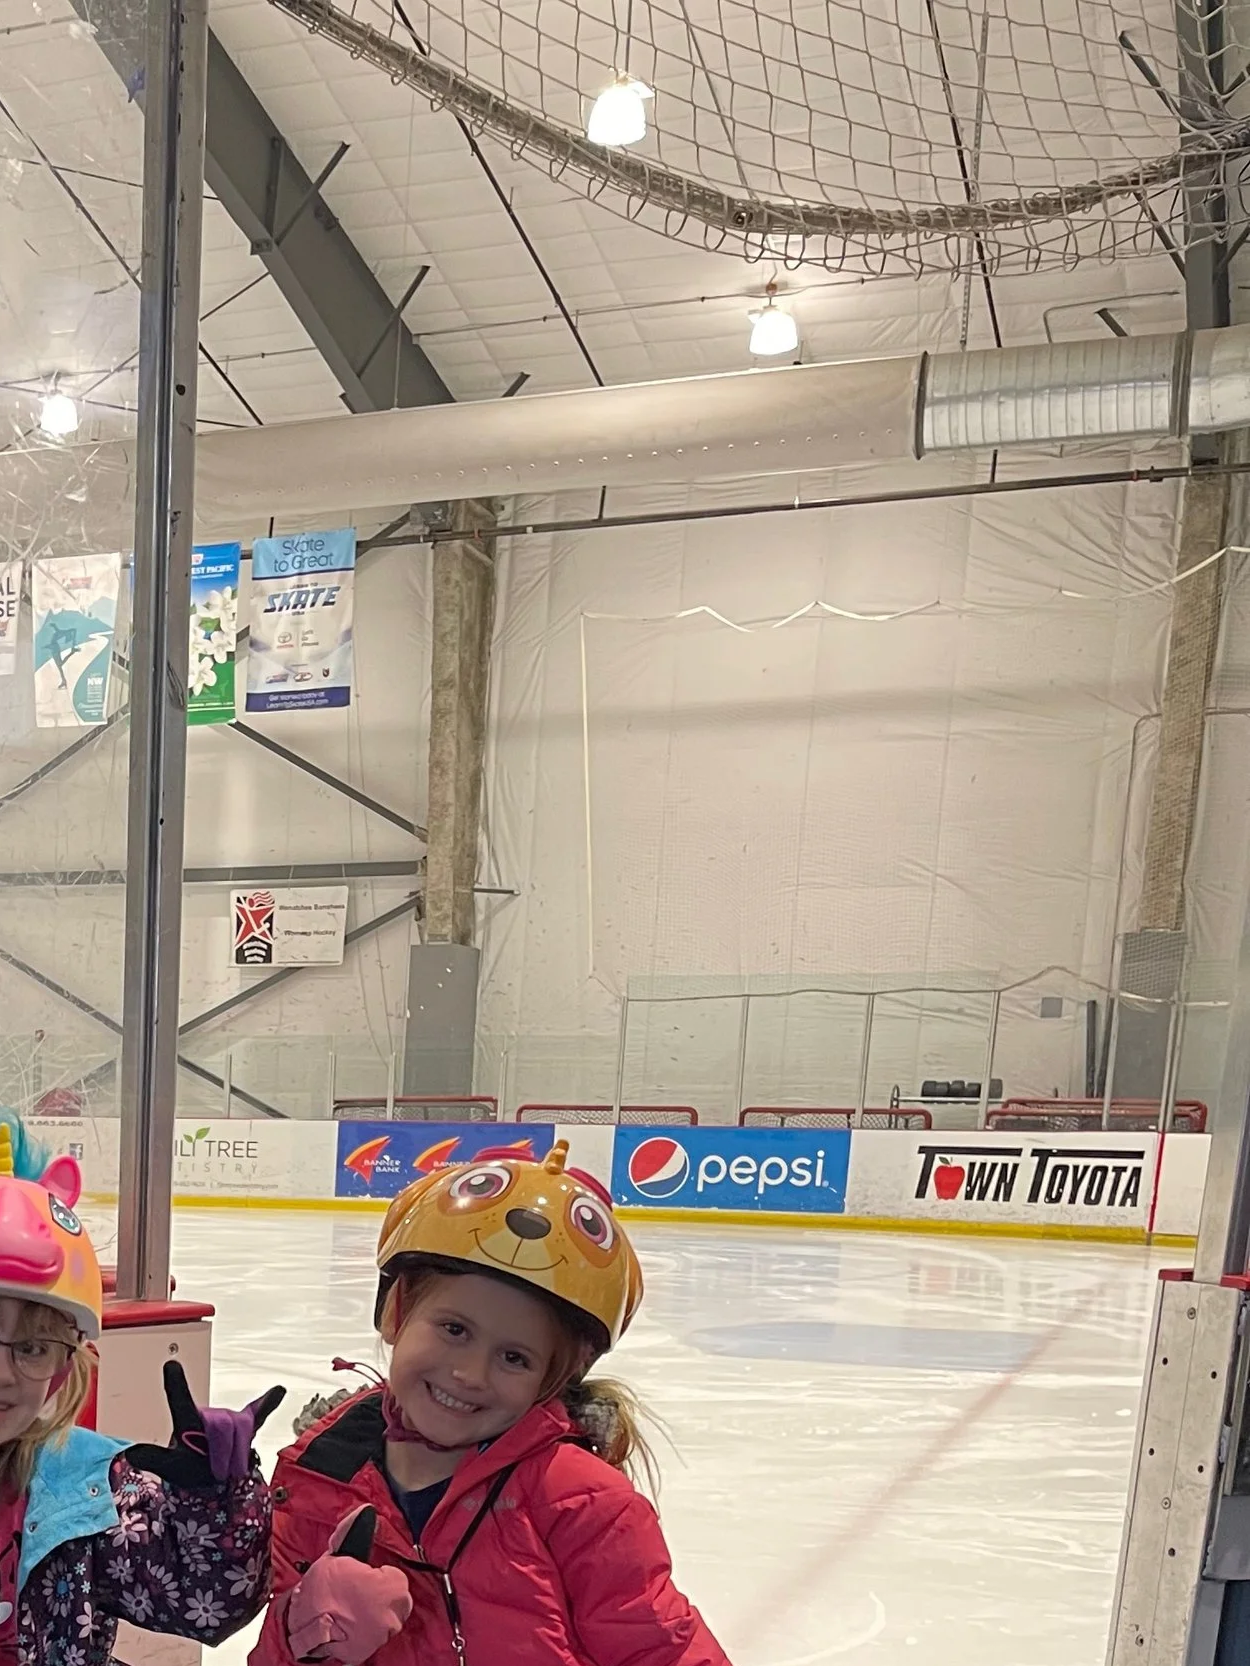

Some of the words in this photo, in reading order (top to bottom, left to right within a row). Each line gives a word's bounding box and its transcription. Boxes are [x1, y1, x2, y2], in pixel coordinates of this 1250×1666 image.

[282, 538, 325, 556] Skate
[274, 559, 289, 573] to
[291, 553, 334, 570] Great
[263, 586, 341, 613] SKATE
[204, 1140, 259, 1158] TREE
[177, 1161, 258, 1173] TISTRY
[363, 1159, 401, 1167] BANNER
[697, 1151, 825, 1194] pepsi
[1027, 1148, 1146, 1207] TOYOTA
